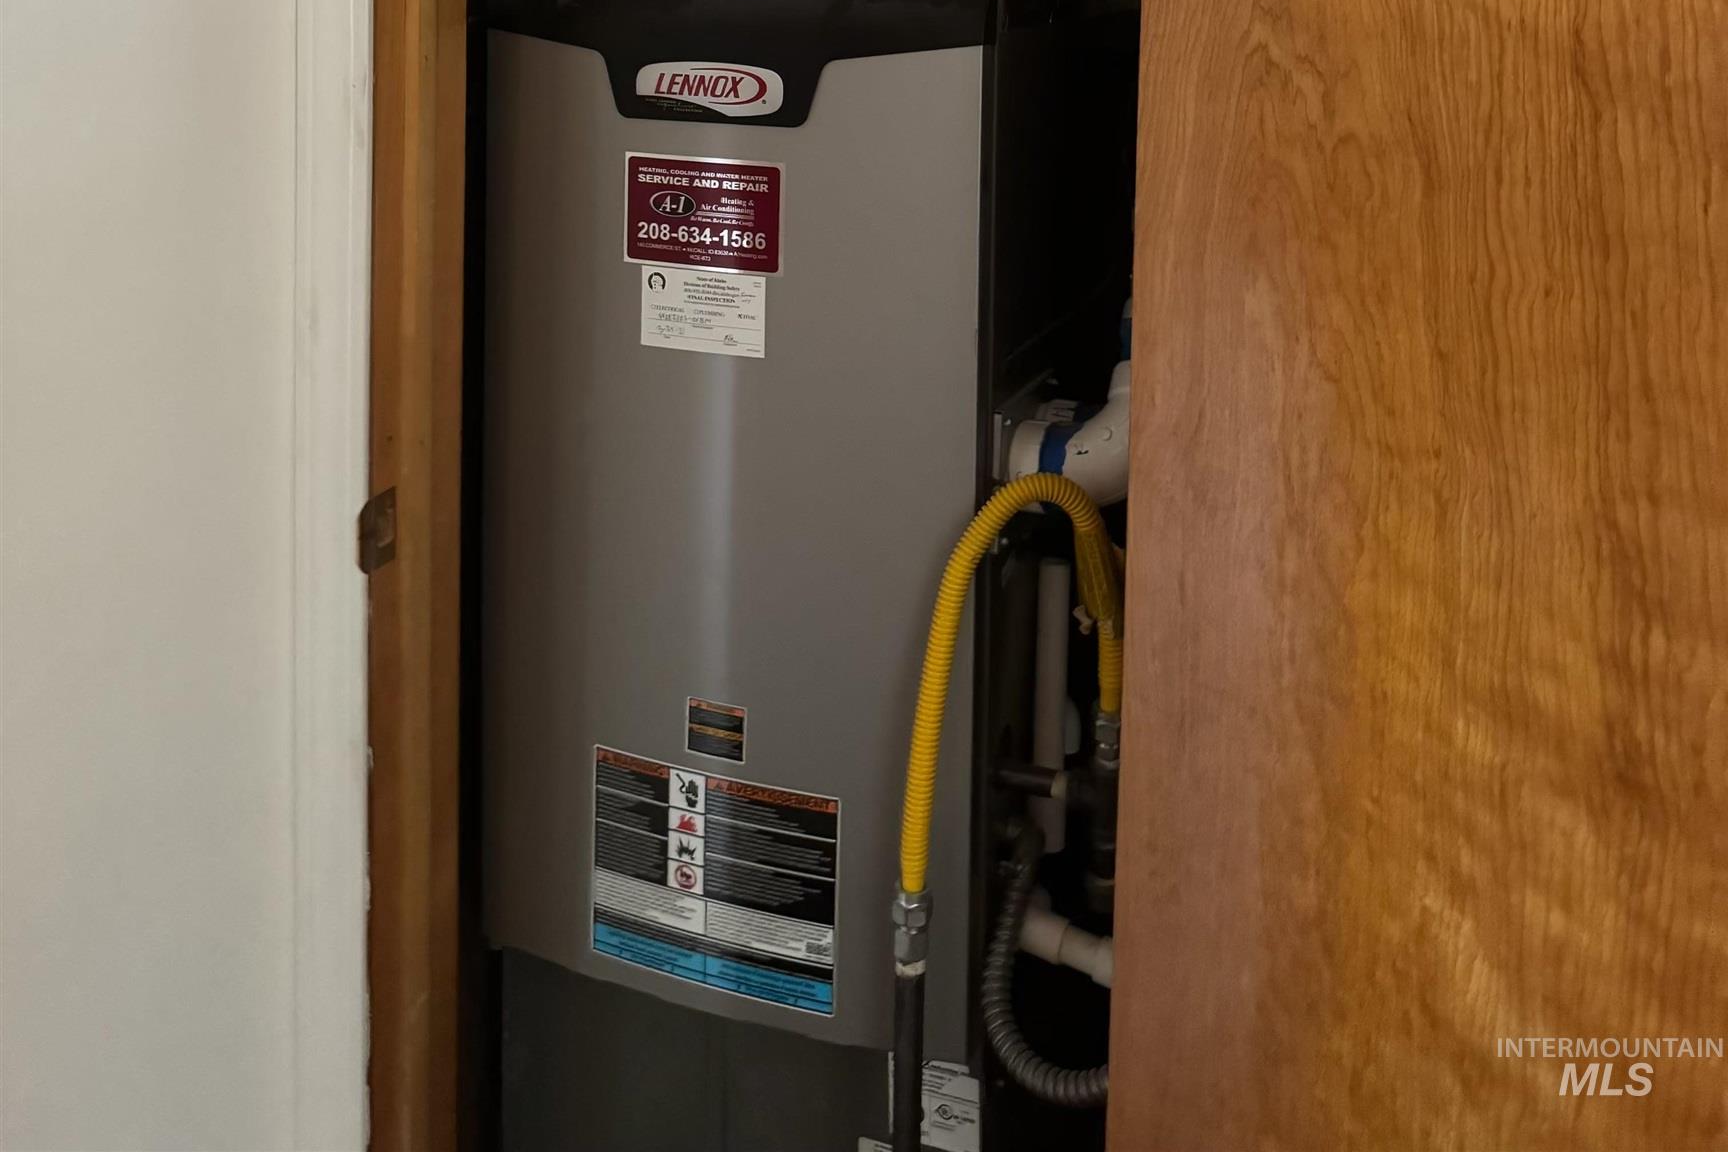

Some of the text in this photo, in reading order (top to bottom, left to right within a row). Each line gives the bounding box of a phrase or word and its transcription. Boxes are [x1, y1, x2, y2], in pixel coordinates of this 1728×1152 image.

[654, 73, 745, 99] LENNOX
[637, 173, 769, 193] SERVICE AND REPAIR
[670, 169, 700, 177] COOLING
[741, 174, 769, 182] HEATER
[658, 194, 686, 213] A-1
[701, 203, 755, 216] Air Conditioning
[720, 196, 747, 207] Heating
[637, 221, 767, 250] 208-634-1586
